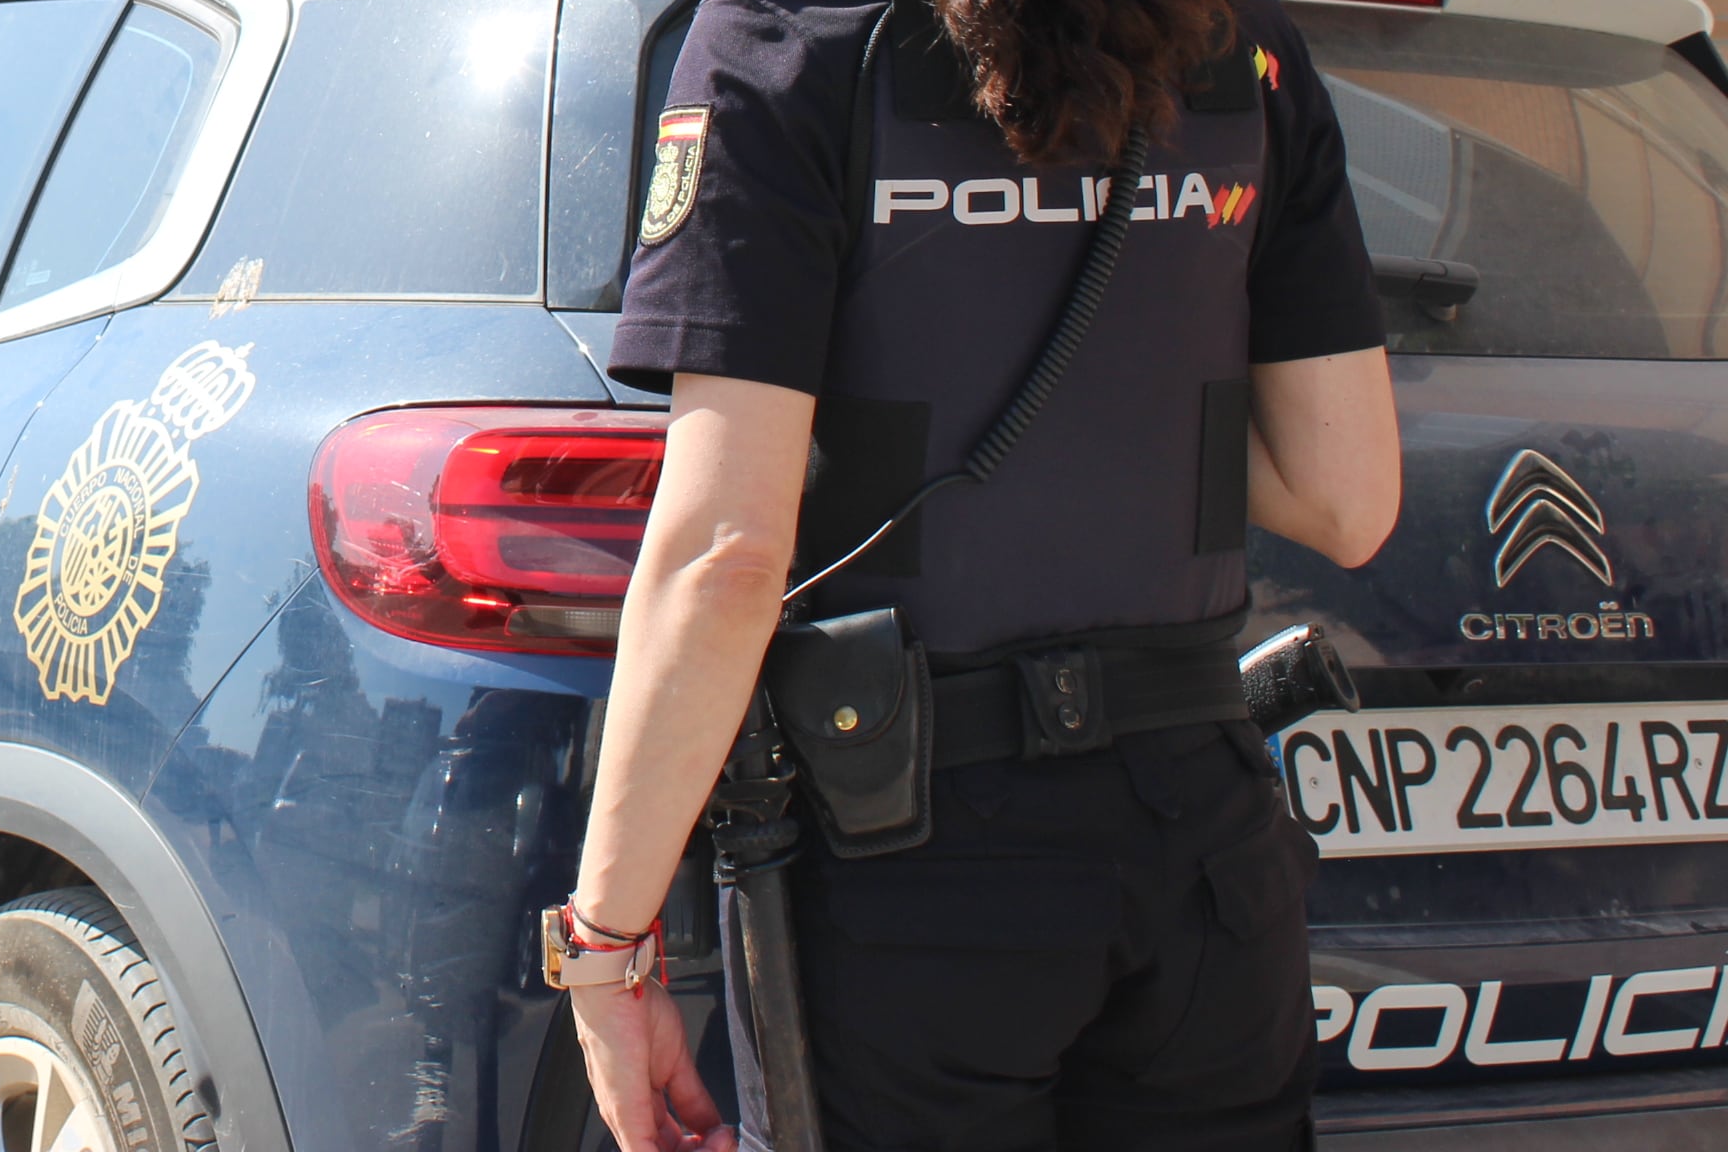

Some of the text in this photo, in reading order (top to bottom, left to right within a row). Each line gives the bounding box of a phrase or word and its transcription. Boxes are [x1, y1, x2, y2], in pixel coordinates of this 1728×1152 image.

[59, 471, 108, 538] CUERPO
[113, 467, 145, 539] NACIONAL
[122, 555, 138, 586] DE
[1311, 963, 1728, 1071] OLICI
